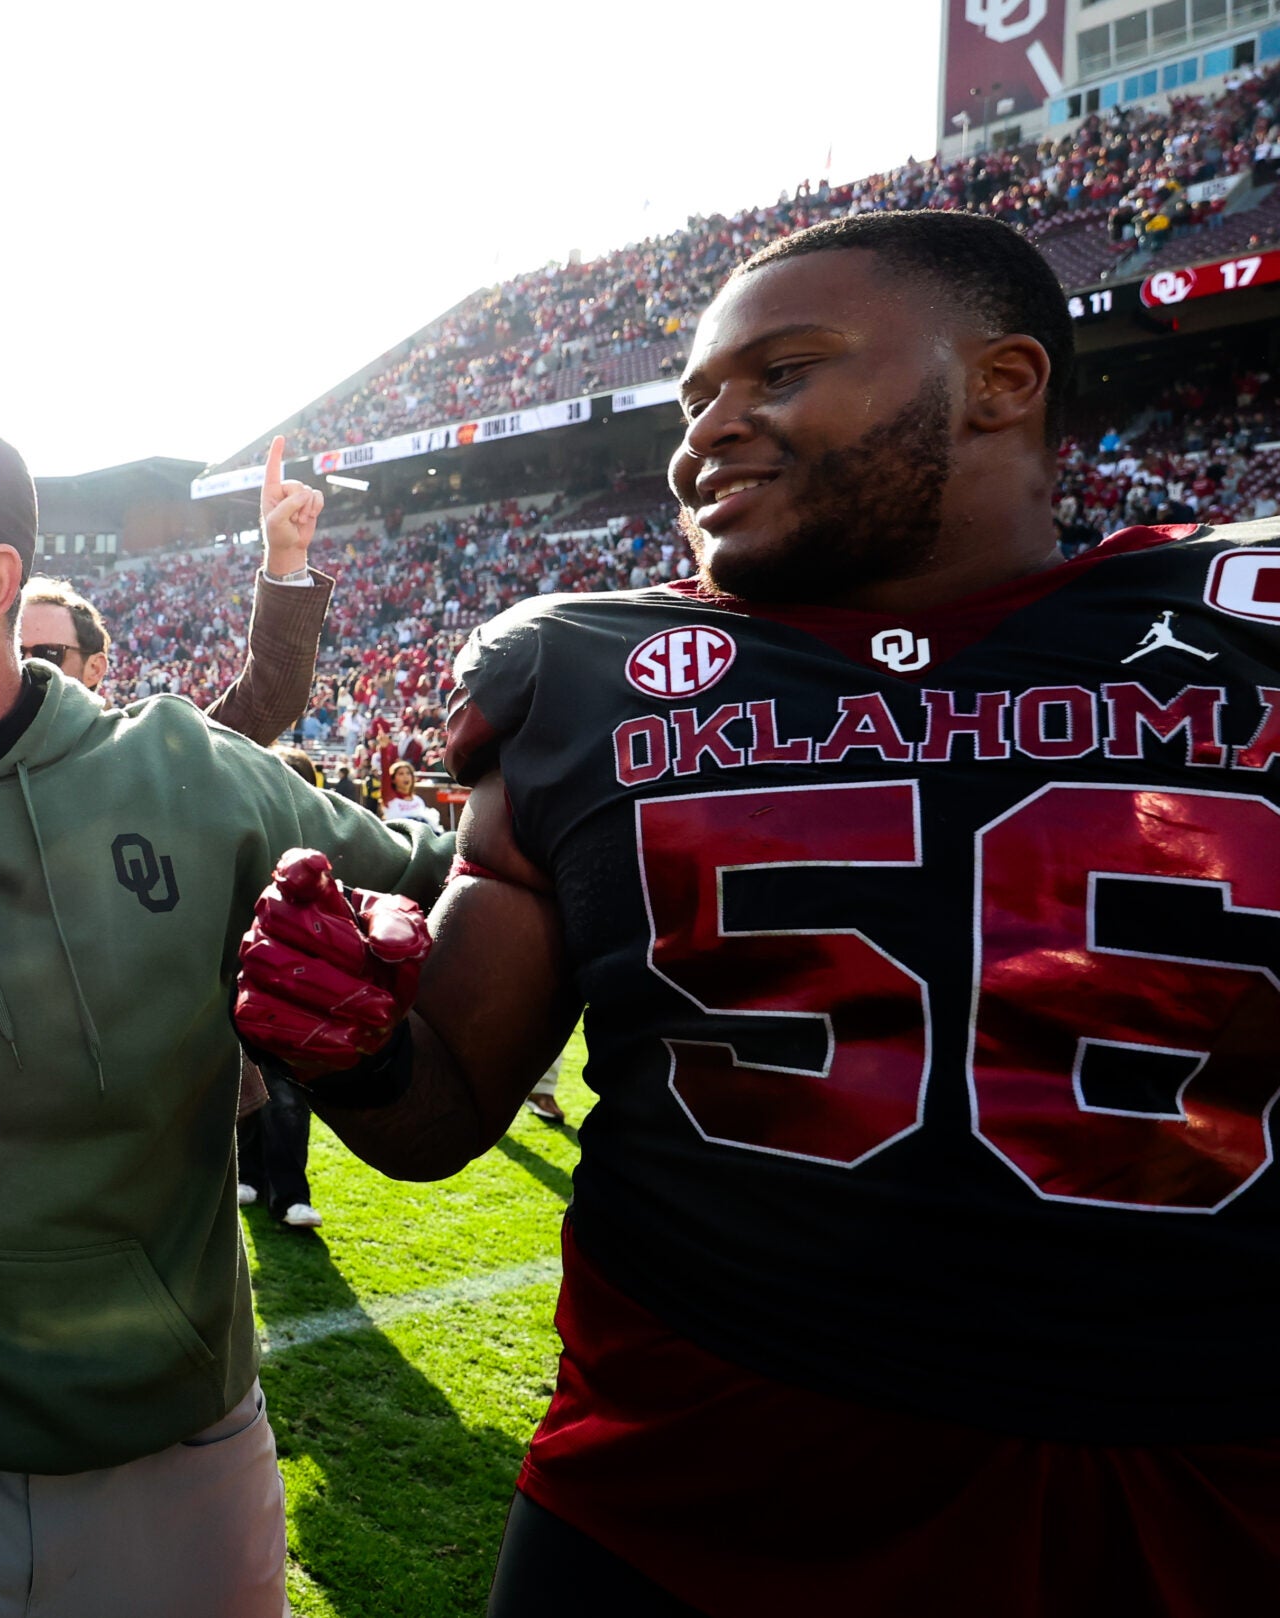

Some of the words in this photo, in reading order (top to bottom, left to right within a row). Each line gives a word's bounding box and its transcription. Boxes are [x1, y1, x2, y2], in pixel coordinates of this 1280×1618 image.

[1150, 271, 1194, 305] OU
[1220, 256, 1262, 290] 17
[1089, 289, 1113, 314] 11
[634, 627, 728, 696] SEC
[871, 628, 930, 672] OU
[110, 832, 180, 914] OU
[635, 779, 1280, 1214] 56
